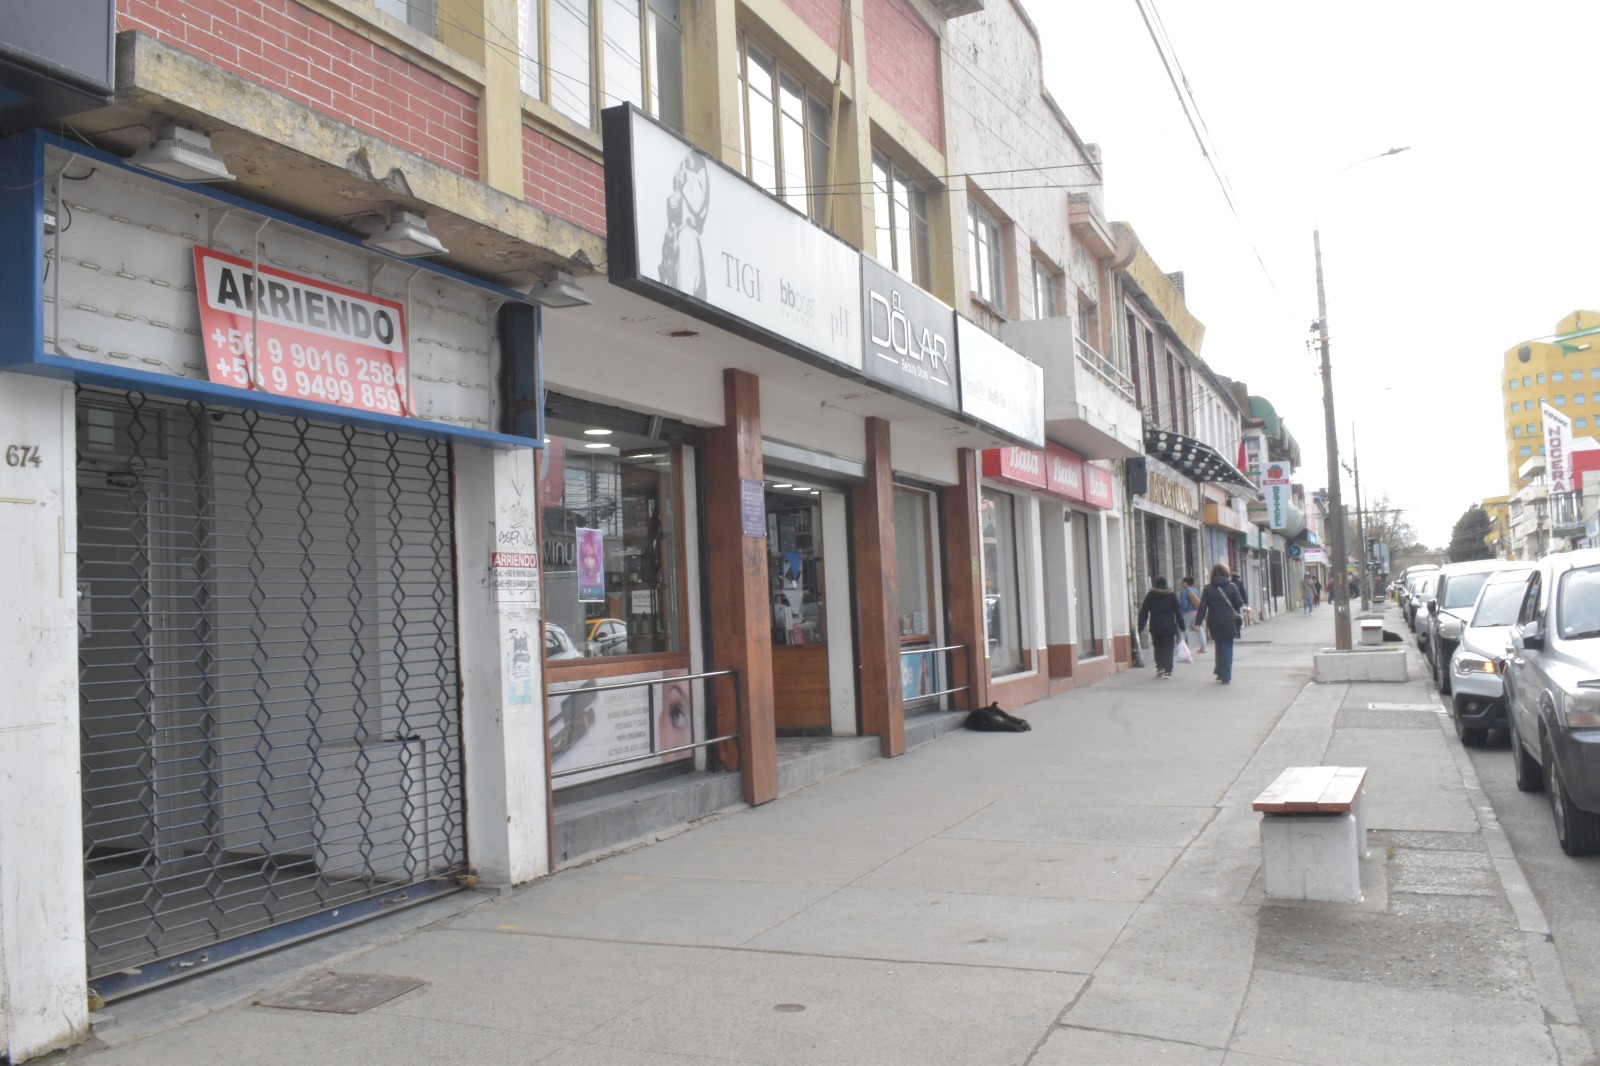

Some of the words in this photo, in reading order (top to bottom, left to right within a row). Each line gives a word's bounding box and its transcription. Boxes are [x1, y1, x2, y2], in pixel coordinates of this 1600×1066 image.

[721, 250, 762, 303] TIGI
[217, 267, 395, 345] ARRIENDO
[892, 289, 905, 314] EL
[830, 306, 849, 344] pH
[211, 328, 260, 359] +56
[267, 337, 283, 364] 9
[290, 342, 350, 377] 9016
[355, 357, 407, 390] 2584
[901, 358, 917, 379] Beauty
[917, 364, 929, 381] Store
[216, 357, 265, 387] +56
[271, 365, 288, 392] 9
[295, 370, 354, 404] 9499
[360, 383, 407, 413] 859
[6, 444, 43, 468] 674
[1009, 447, 1040, 476] Bata
[1052, 456, 1079, 490] Bata
[1548, 425, 1566, 492] NOCERA
[1089, 471, 1108, 499] Bata
[1272, 486, 1282, 527] BESTCEL
[494, 553, 536, 568] ARRIENDO
